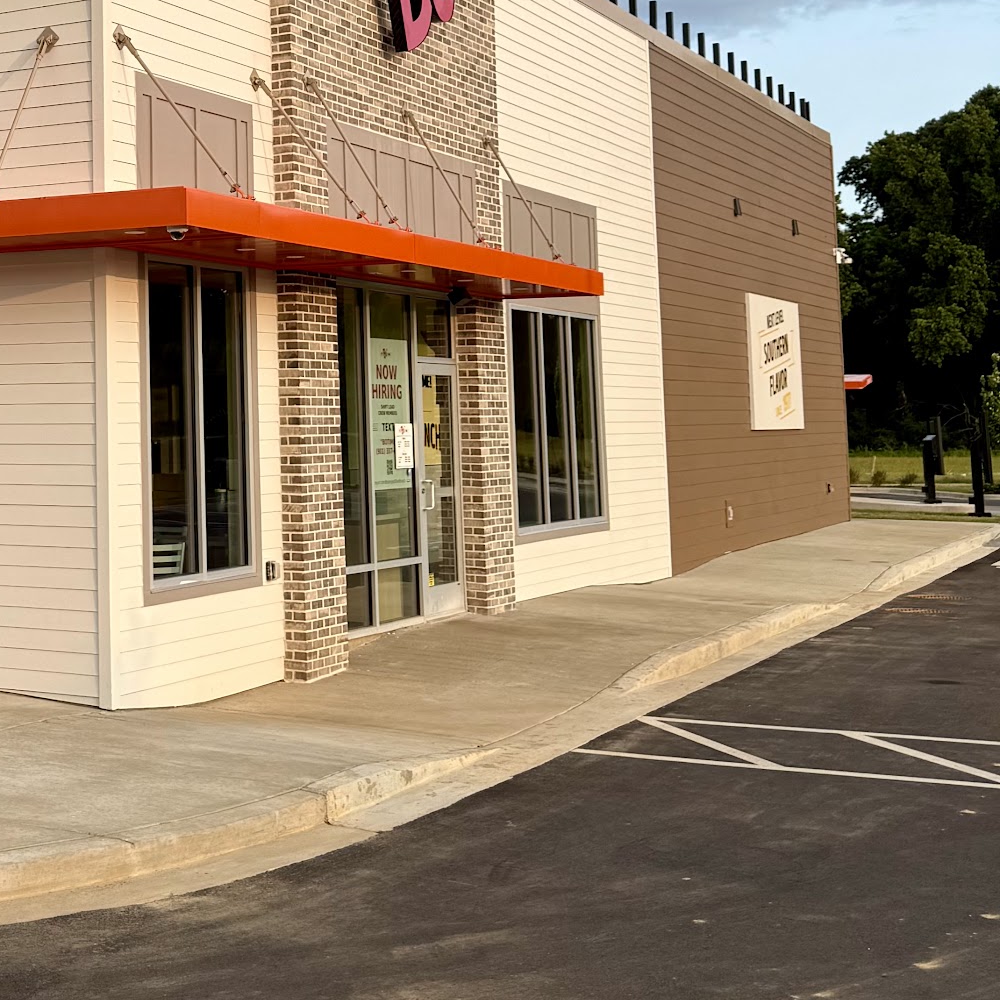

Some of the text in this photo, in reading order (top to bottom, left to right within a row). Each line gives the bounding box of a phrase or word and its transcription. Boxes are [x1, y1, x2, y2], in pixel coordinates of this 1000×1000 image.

[764, 333, 789, 365] SOUTHERN
[376, 364, 397, 379] NOW
[769, 368, 788, 397] FLAVOR
[372, 384, 402, 399] HIRING
